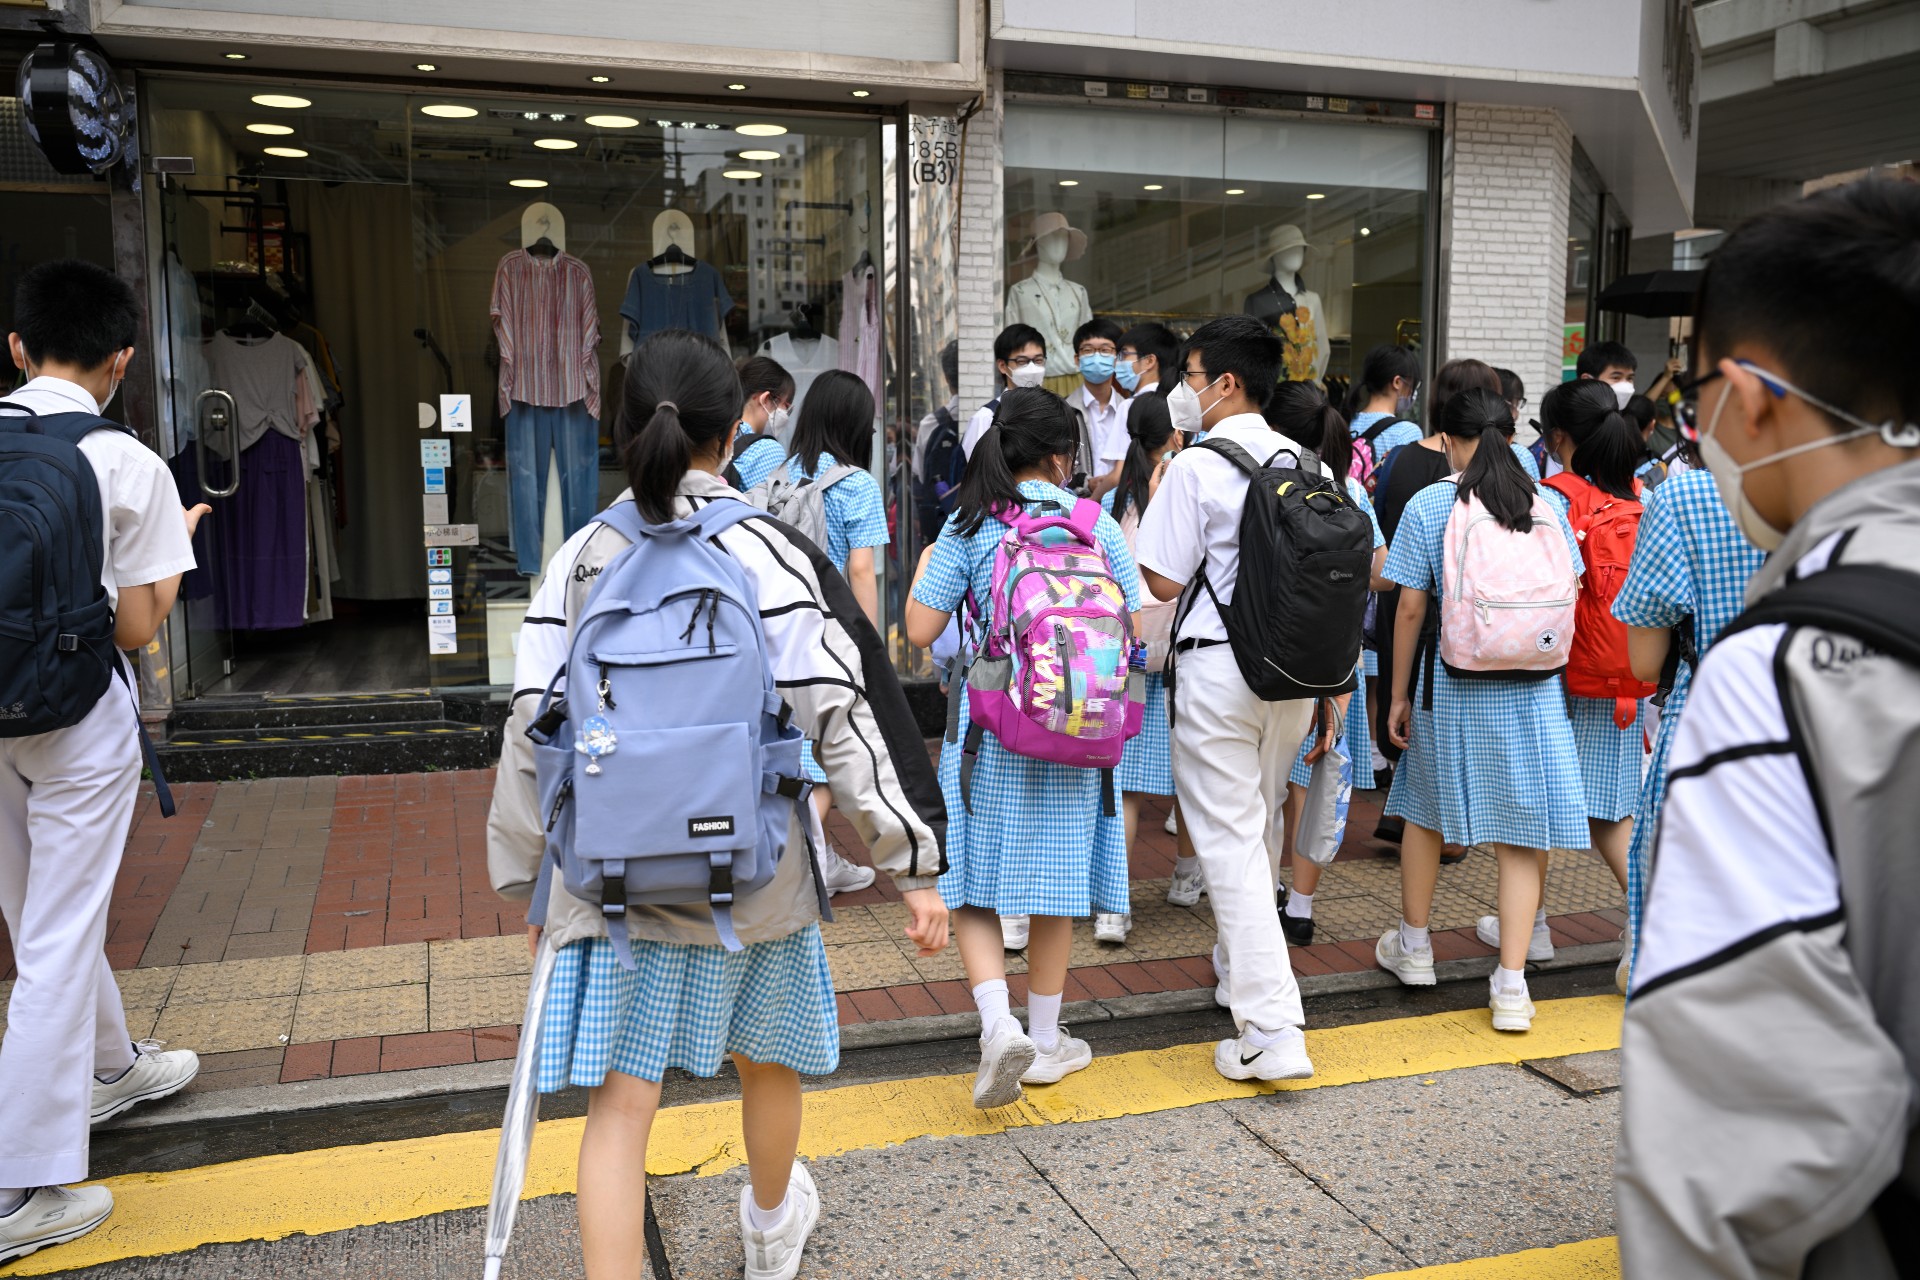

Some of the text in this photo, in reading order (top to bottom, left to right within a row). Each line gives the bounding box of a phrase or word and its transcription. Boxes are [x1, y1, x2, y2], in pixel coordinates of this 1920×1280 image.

[909, 118, 958, 136] 太子道
[909, 140, 958, 160] 185B
[913, 160, 954, 186] (B3)
[432, 588, 450, 596] VISA
[692, 821, 730, 832] FASHION
